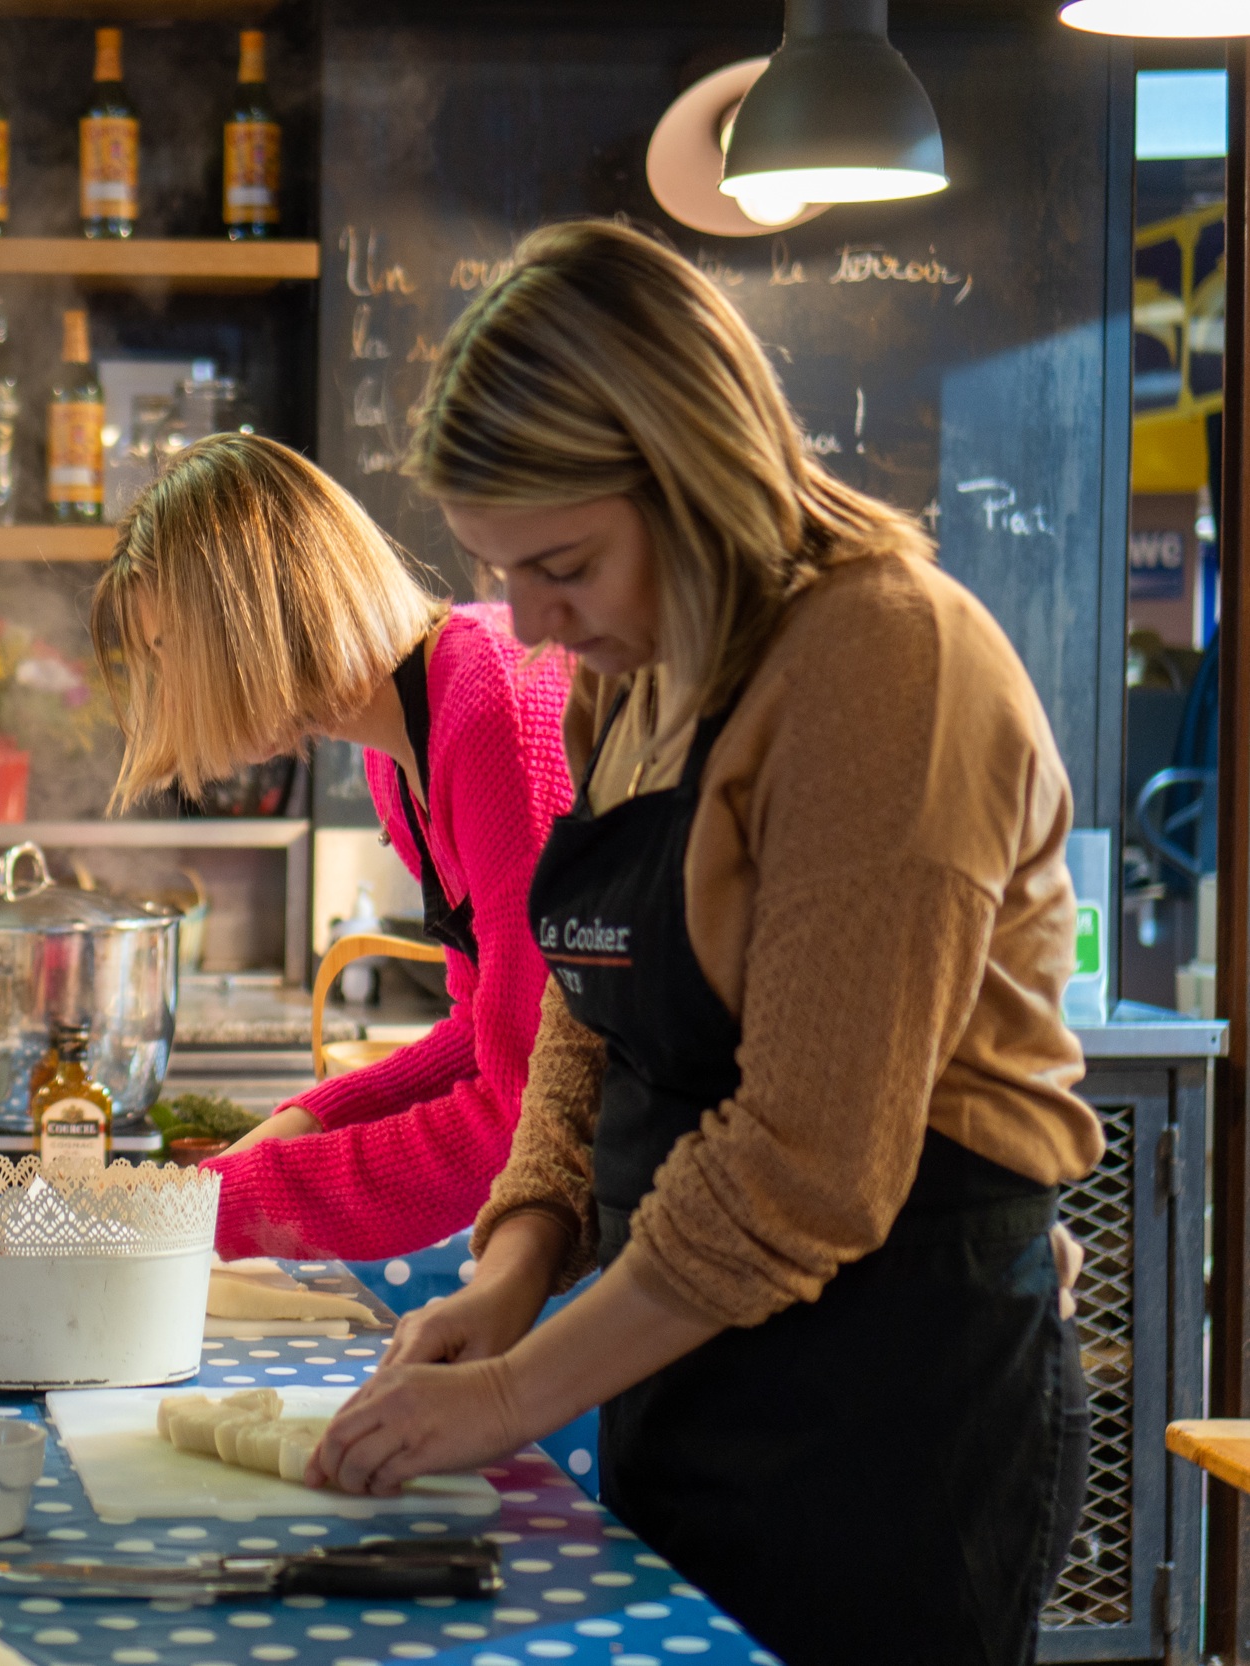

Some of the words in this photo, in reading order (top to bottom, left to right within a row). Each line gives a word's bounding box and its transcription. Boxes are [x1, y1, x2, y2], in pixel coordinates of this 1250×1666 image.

[338, 224, 417, 297] Un
[770, 236, 806, 286] le
[539, 916, 558, 949] Le
[563, 916, 630, 953] Cooker
